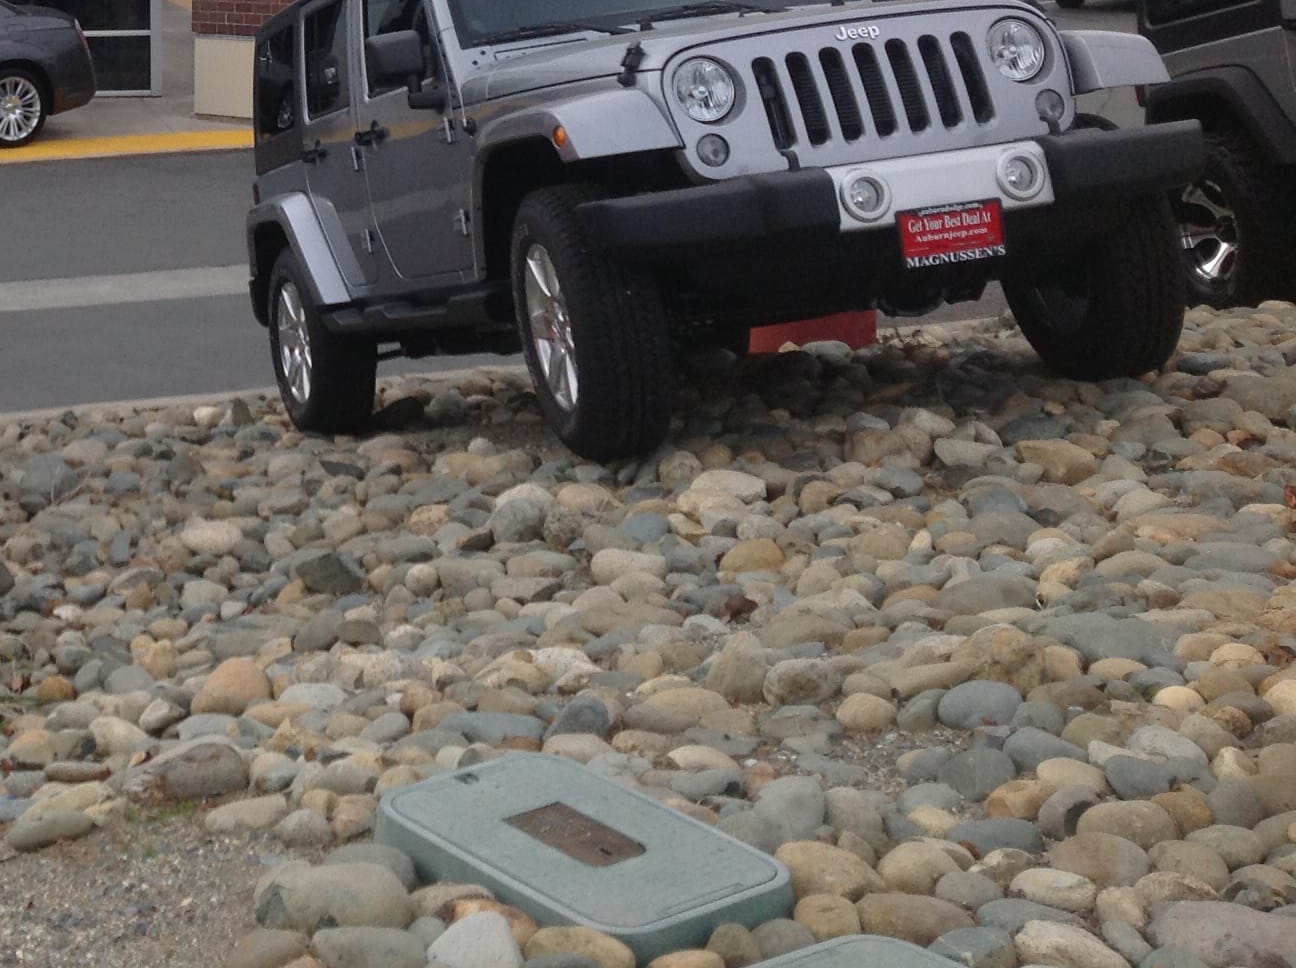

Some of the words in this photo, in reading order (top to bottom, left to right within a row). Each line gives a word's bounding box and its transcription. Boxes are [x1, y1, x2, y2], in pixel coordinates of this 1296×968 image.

[835, 25, 881, 41] Jeep
[908, 219, 923, 234] Get
[923, 215, 943, 232] Your
[944, 214, 961, 229] Best
[962, 211, 980, 226] Deal
[906, 245, 1006, 268] MAGNUSSEN'S
